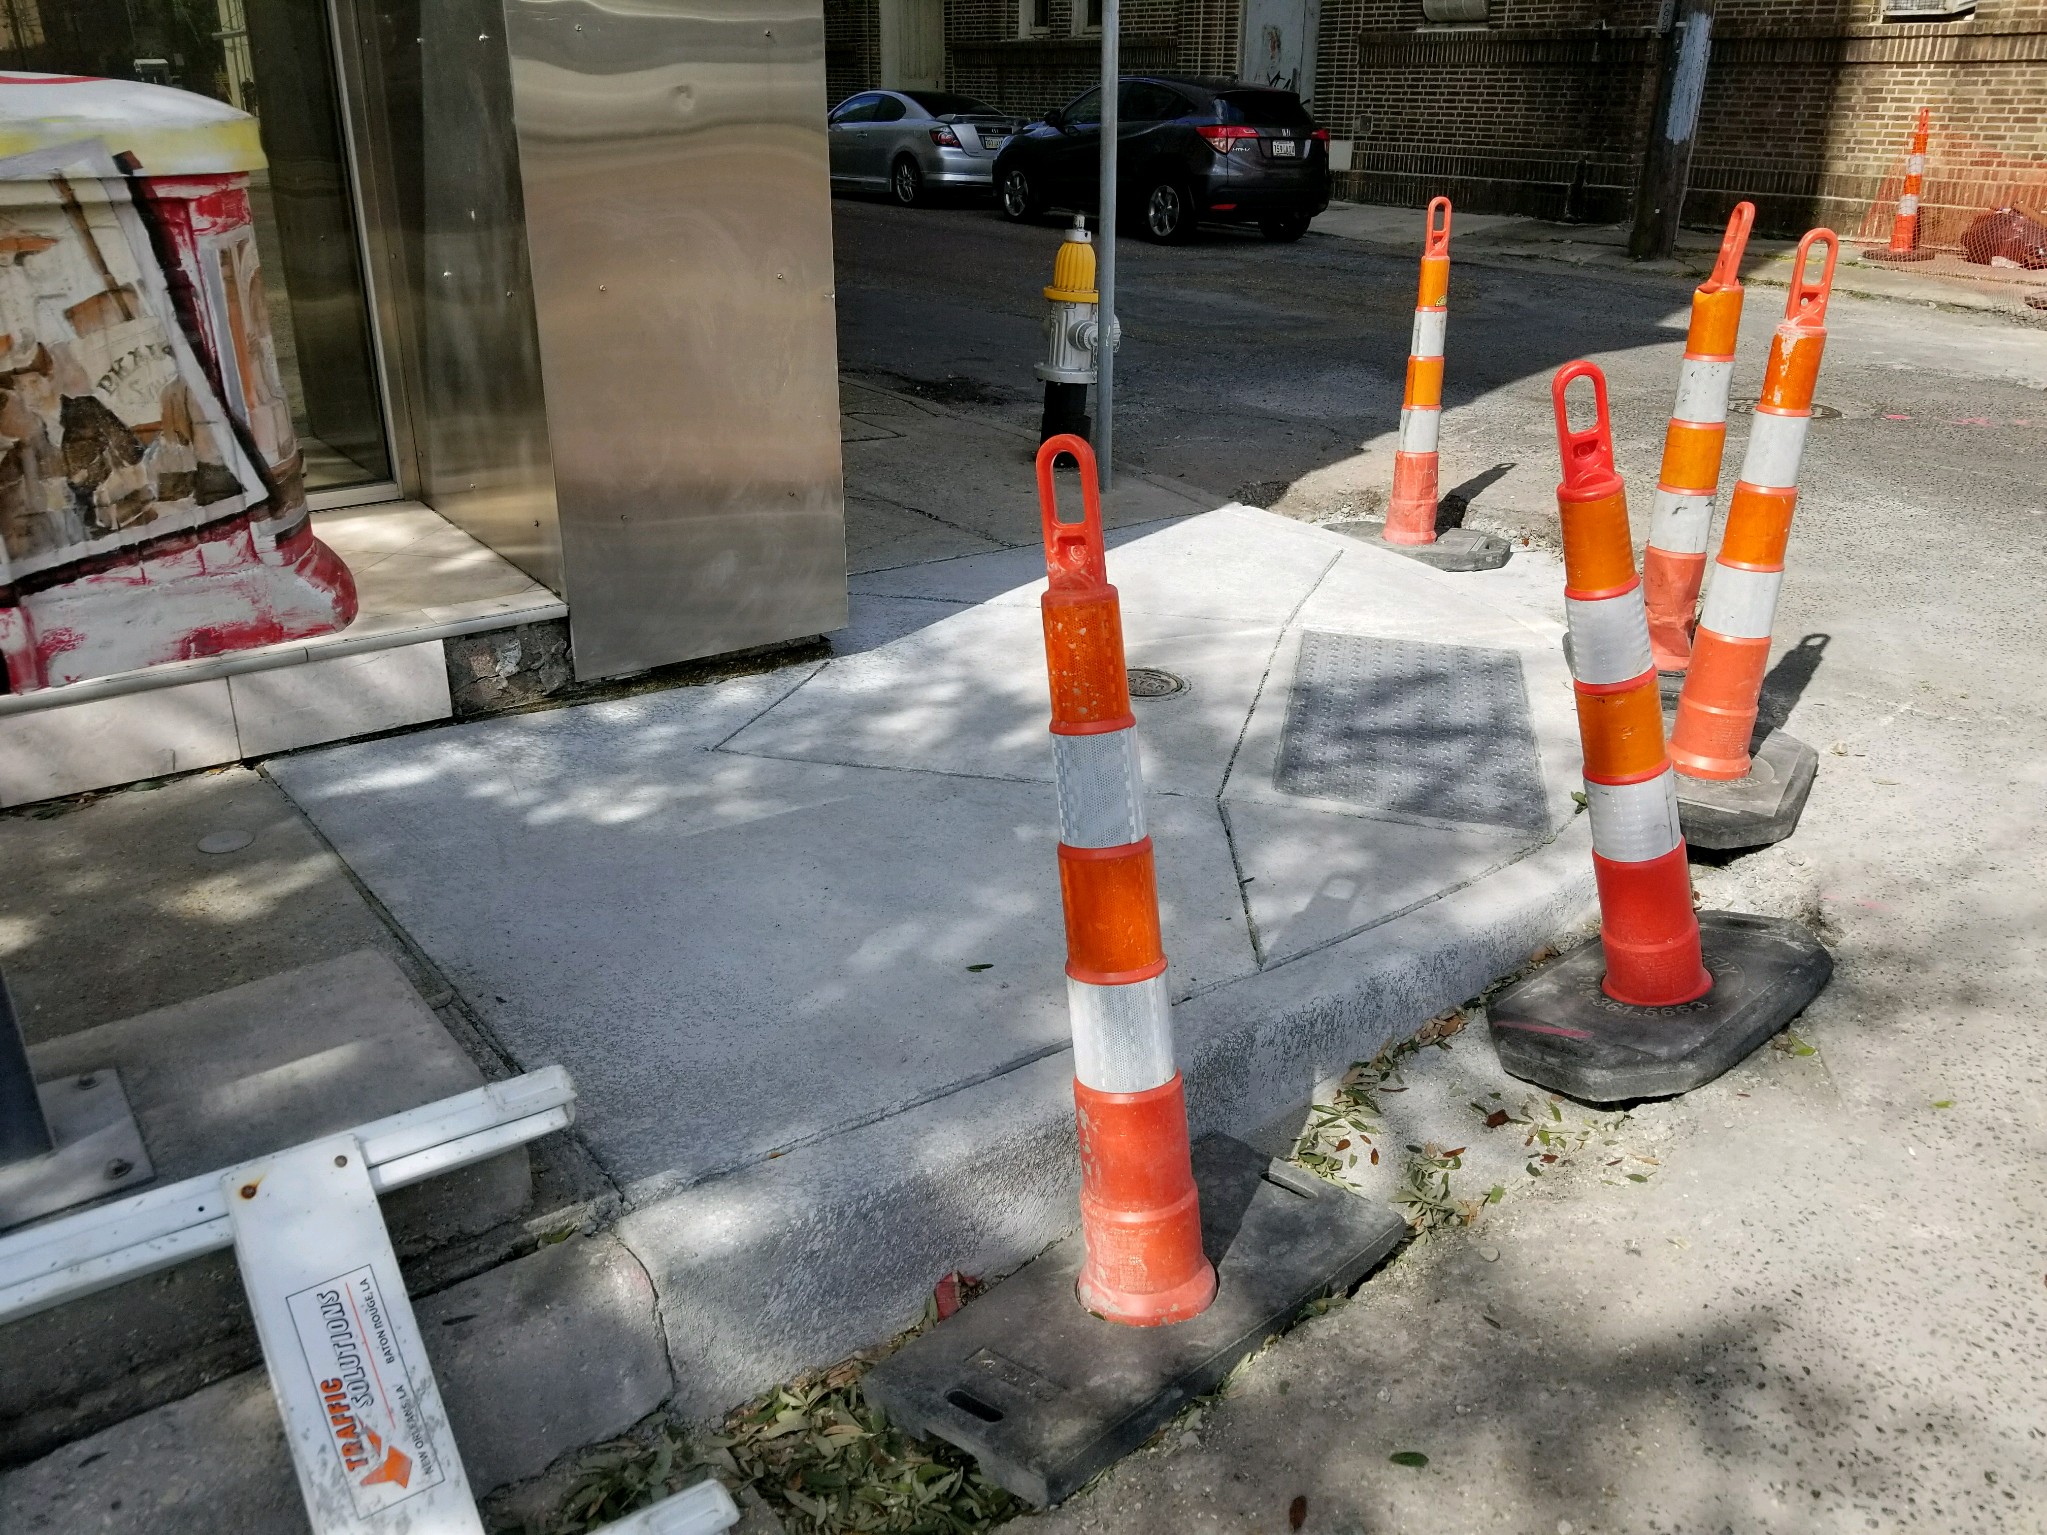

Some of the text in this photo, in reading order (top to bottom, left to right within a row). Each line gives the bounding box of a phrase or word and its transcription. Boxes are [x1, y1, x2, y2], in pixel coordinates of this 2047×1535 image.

[317, 1289, 374, 1409] SOLUTIONS
[359, 1277, 395, 1364] BATON ROUGE, LA
[320, 1377, 371, 1473] TRAFFIC
[395, 1384, 406, 1400] LA
[418, 1449, 434, 1475] NEW
